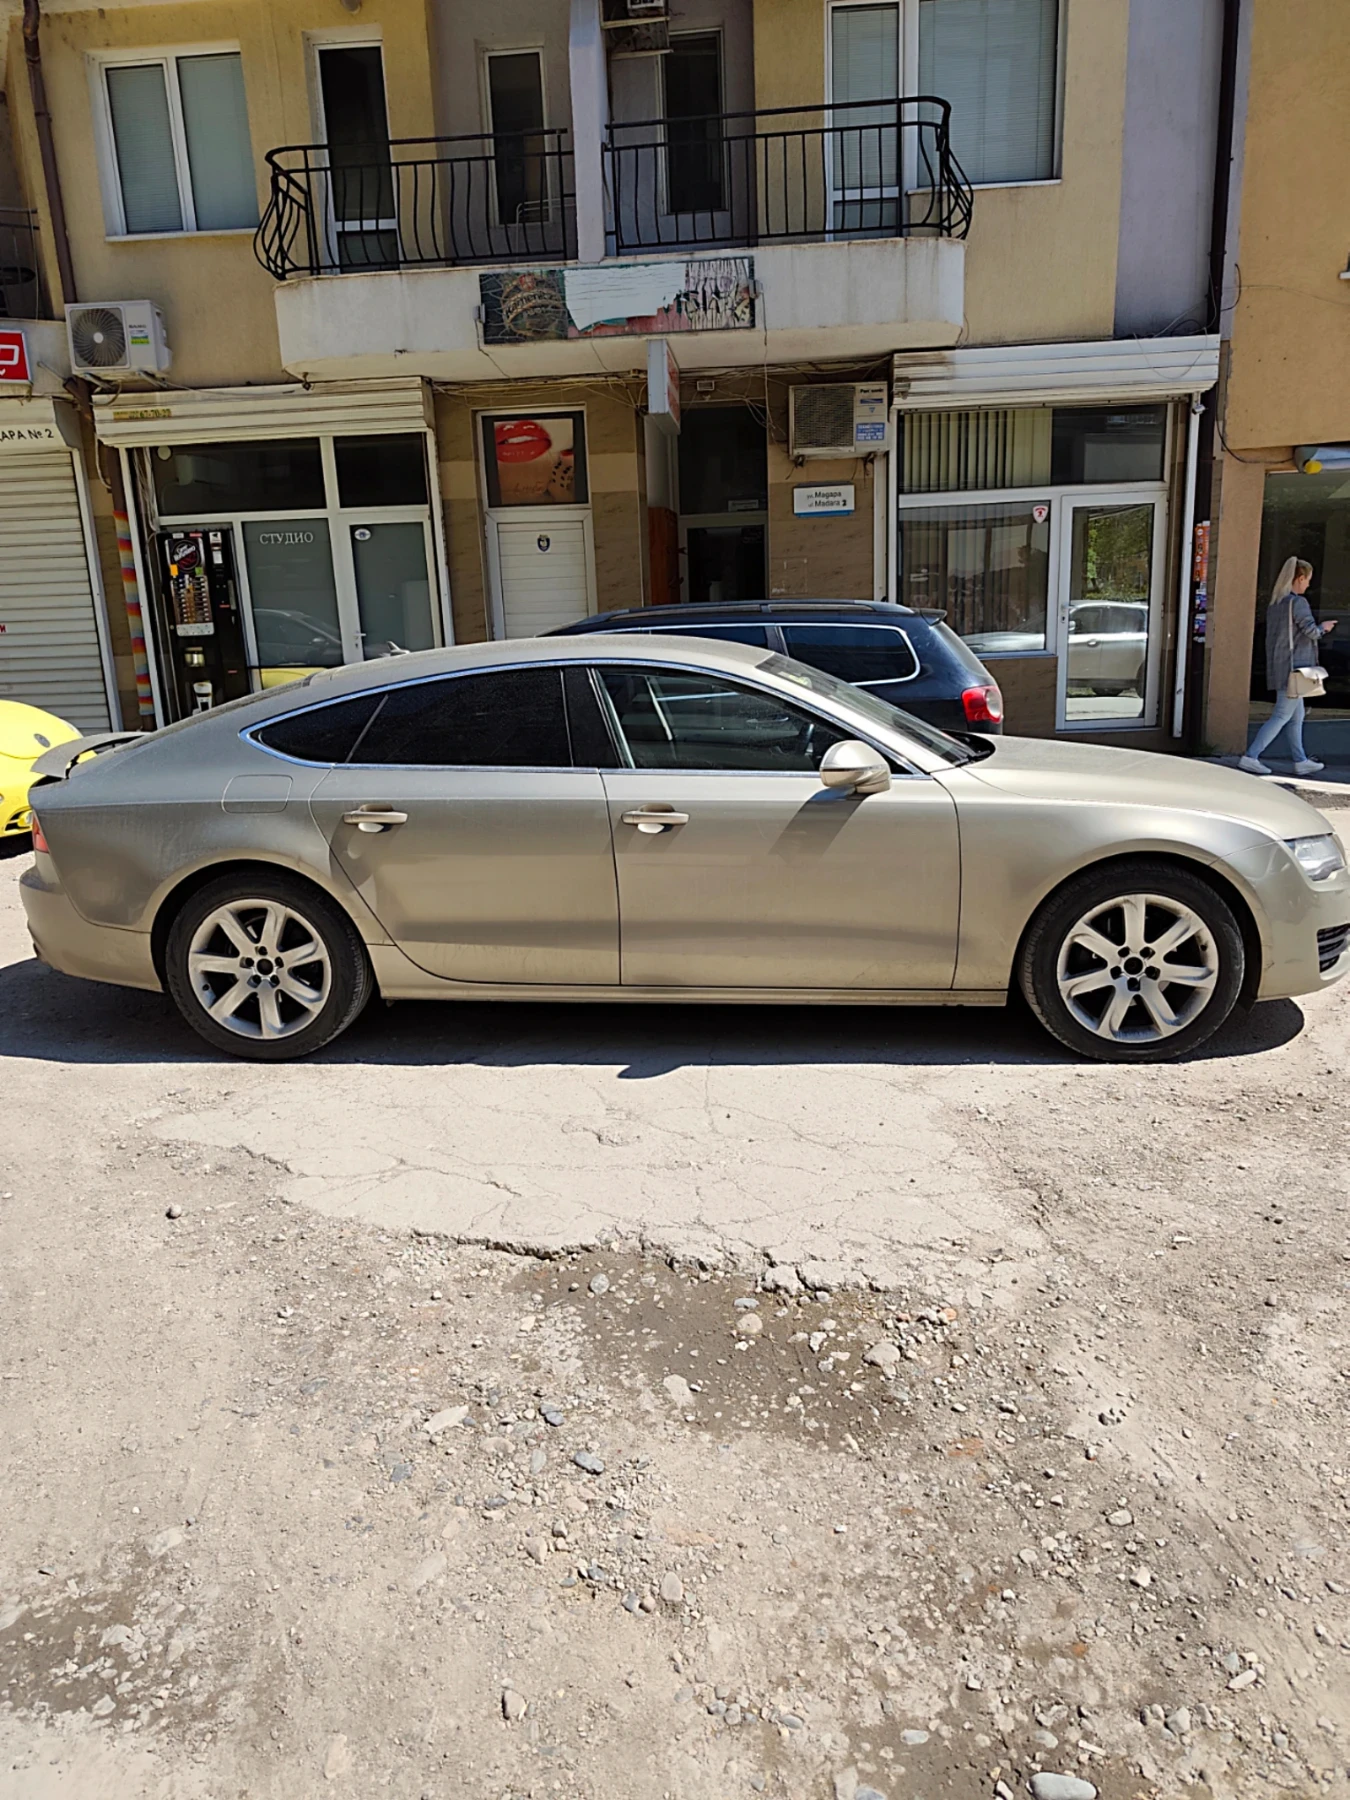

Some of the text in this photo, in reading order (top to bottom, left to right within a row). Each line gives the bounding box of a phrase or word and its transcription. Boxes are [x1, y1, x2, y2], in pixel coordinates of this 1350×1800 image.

[0, 429, 27, 442] АРА
[45, 428, 54, 438] 2
[259, 532, 314, 545] СТУДИО
